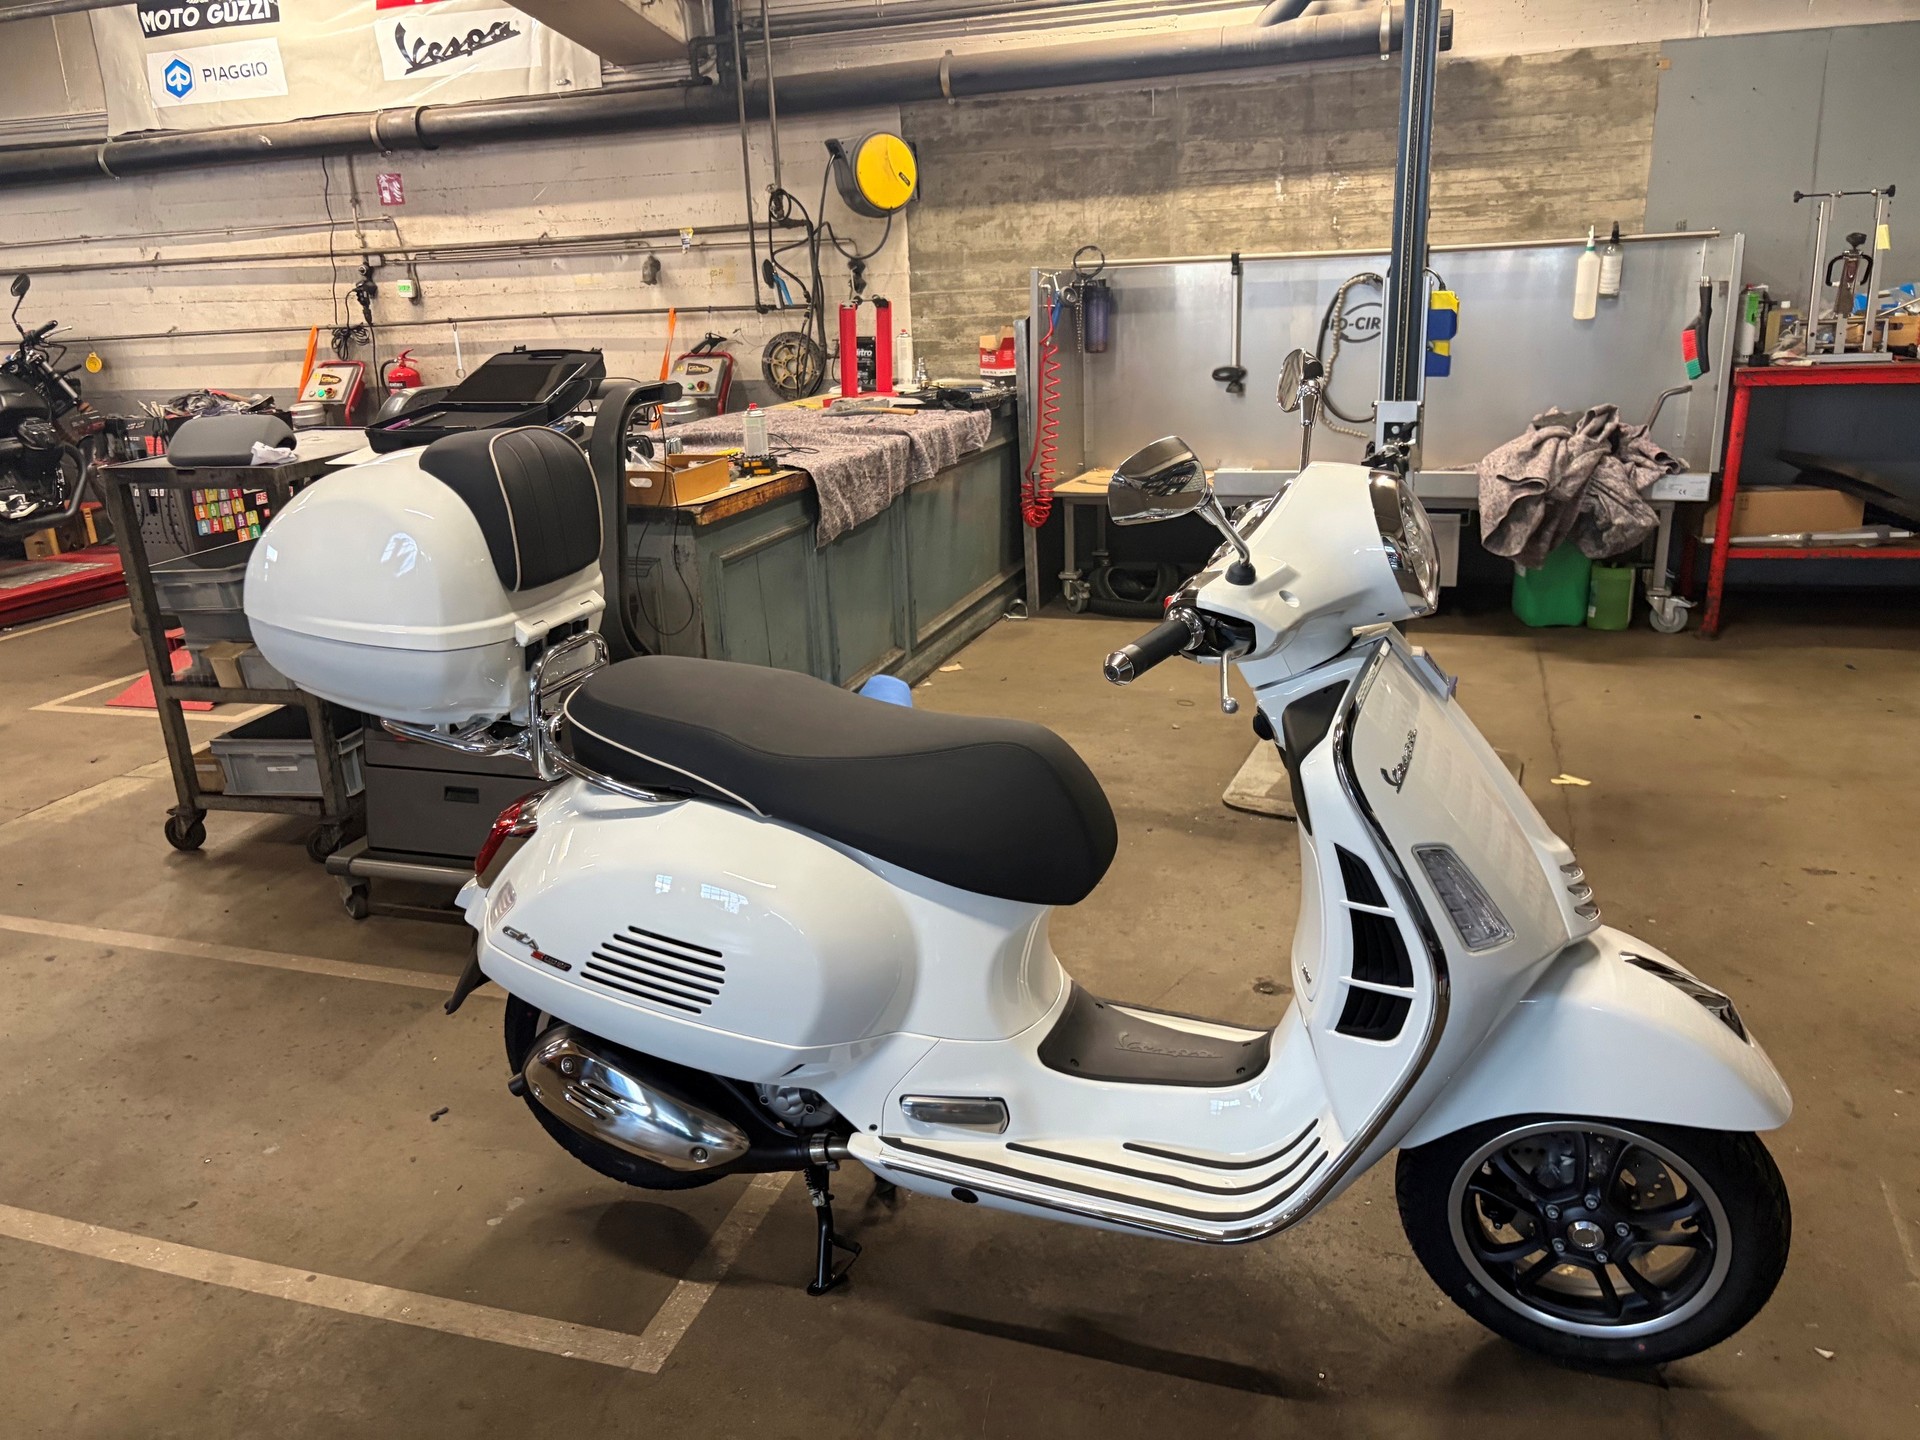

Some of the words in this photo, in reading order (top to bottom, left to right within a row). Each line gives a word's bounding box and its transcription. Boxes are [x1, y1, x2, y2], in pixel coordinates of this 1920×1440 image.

[140, 7, 200, 33] MOTO
[206, 0, 271, 24] GUZZI
[395, 22, 521, 75] Vespa
[202, 61, 268, 82] PIAGGIO
[1380, 728, 1418, 794] Vespa
[1115, 1032, 1223, 1058] Vespa
